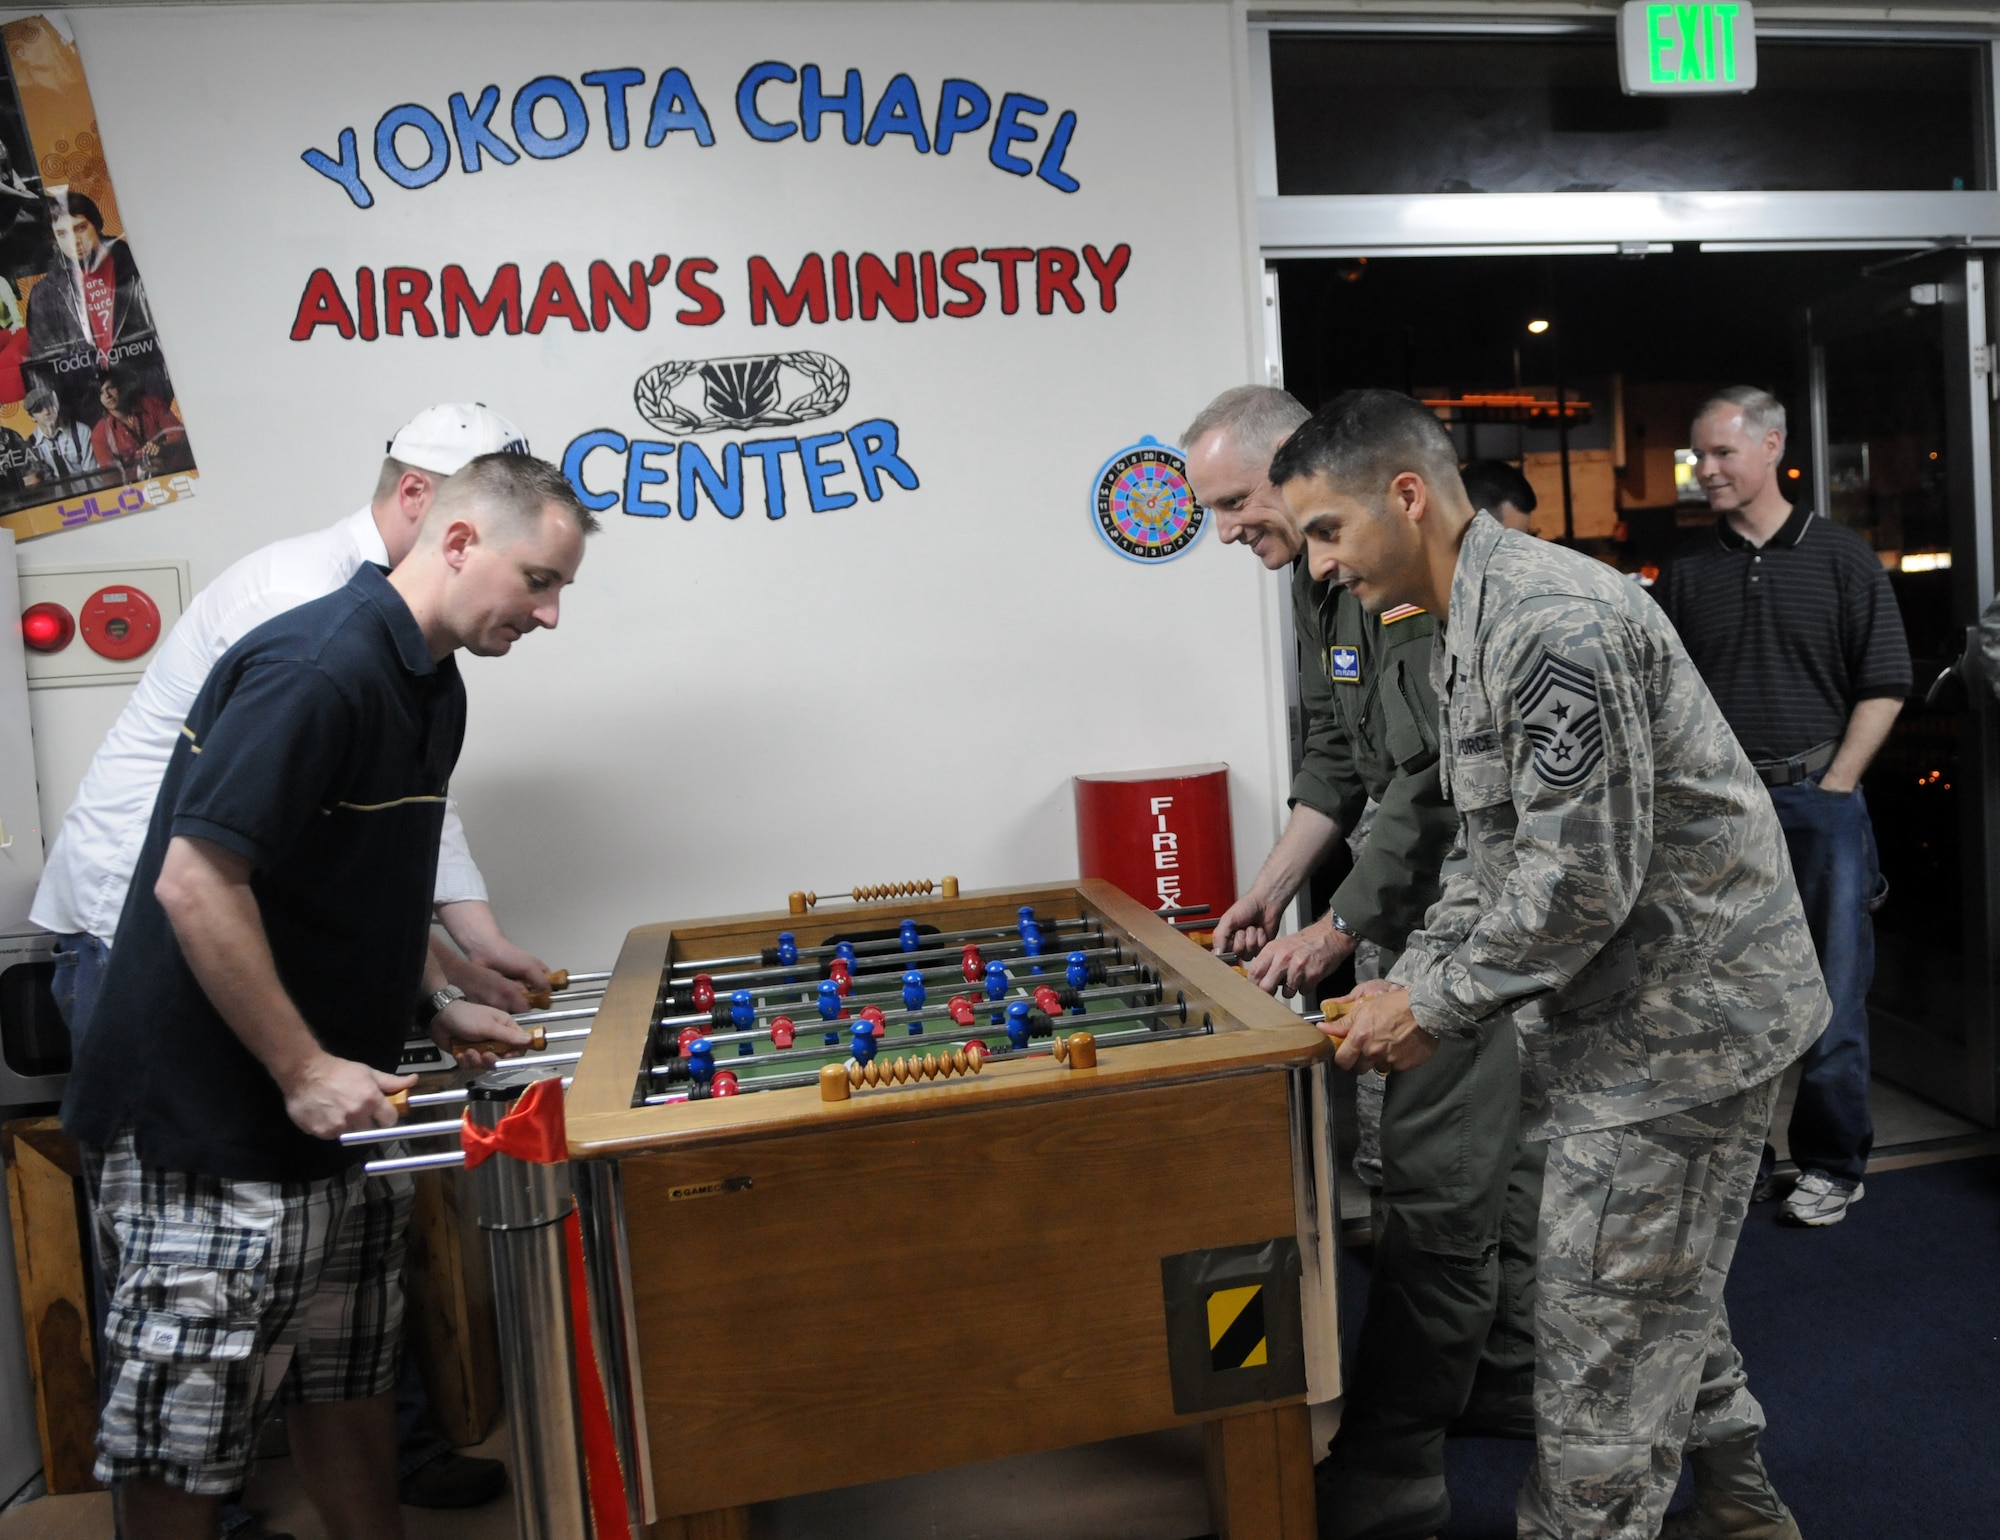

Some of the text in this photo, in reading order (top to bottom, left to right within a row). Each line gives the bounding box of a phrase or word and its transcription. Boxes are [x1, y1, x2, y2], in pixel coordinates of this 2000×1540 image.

[1646, 3, 1740, 83] EXIT
[301, 60, 1081, 209] YOKOTA CHAPEL
[86, 278, 104, 289] are
[88, 297, 112, 311] sure
[90, 288, 107, 302] you
[289, 243, 1132, 341] AIRMAN'S MINISTRY
[48, 350, 91, 374] Todd
[96, 339, 153, 366] Agnew
[561, 418, 920, 521] CENTER
[1457, 734, 1496, 756] FORCE
[1150, 796, 1179, 870] FIRE
